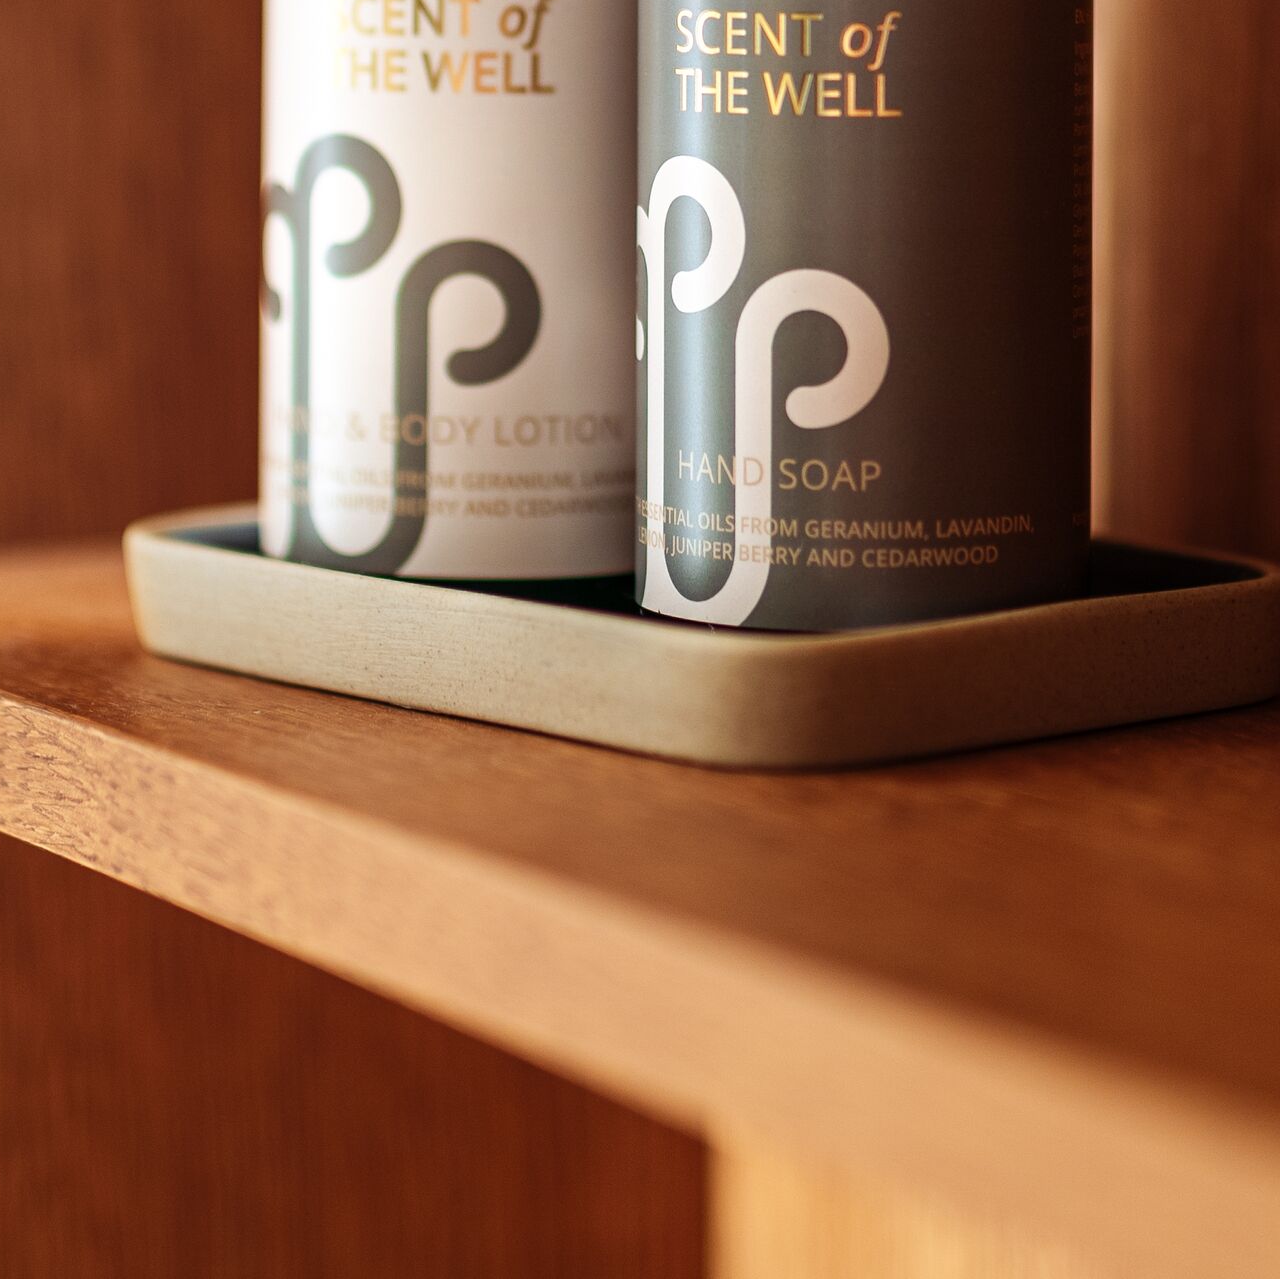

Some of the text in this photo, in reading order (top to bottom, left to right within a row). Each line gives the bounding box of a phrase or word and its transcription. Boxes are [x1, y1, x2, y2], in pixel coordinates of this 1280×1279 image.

[676, 8, 903, 71] SCENT of
[421, 50, 556, 94] WELL
[674, 68, 903, 117] THE WELL
[379, 412, 482, 446] BODY
[493, 413, 624, 447] LOTION
[678, 449, 764, 487] HAND
[778, 457, 882, 492] SOAP
[698, 511, 735, 532] OILS
[740, 517, 798, 537] FROM
[804, 519, 929, 541] GERANIUM,
[935, 514, 1035, 540] LAVANDIN,
[670, 534, 734, 561] JUNIPER
[739, 543, 801, 565] BERRY
[806, 548, 855, 568] AND
[862, 545, 998, 568] CEDARWOOD
